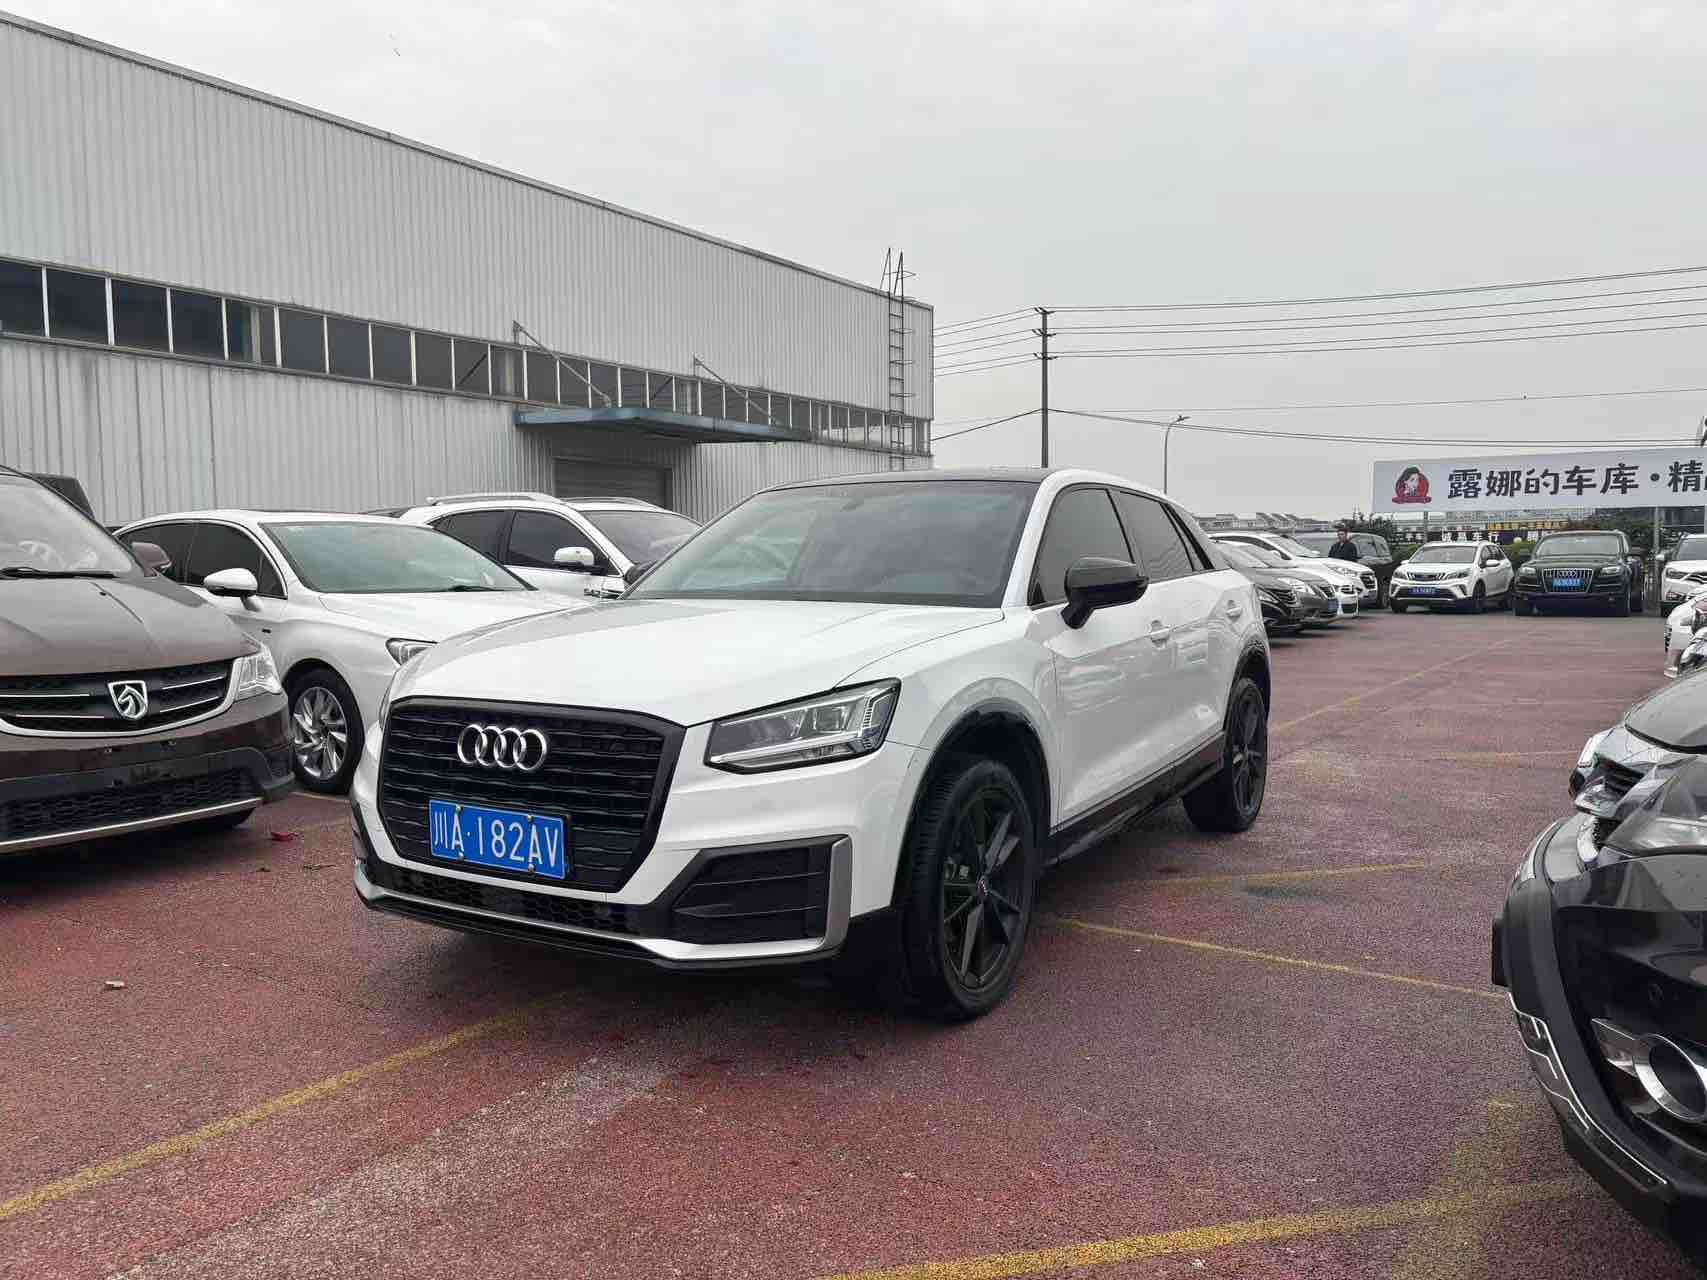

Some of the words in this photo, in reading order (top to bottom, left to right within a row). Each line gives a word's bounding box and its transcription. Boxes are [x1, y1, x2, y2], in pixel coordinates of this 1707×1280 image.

[1448, 459, 1707, 499] 露娜的车库·精
[434, 810, 559, 868] 川A·182AV
